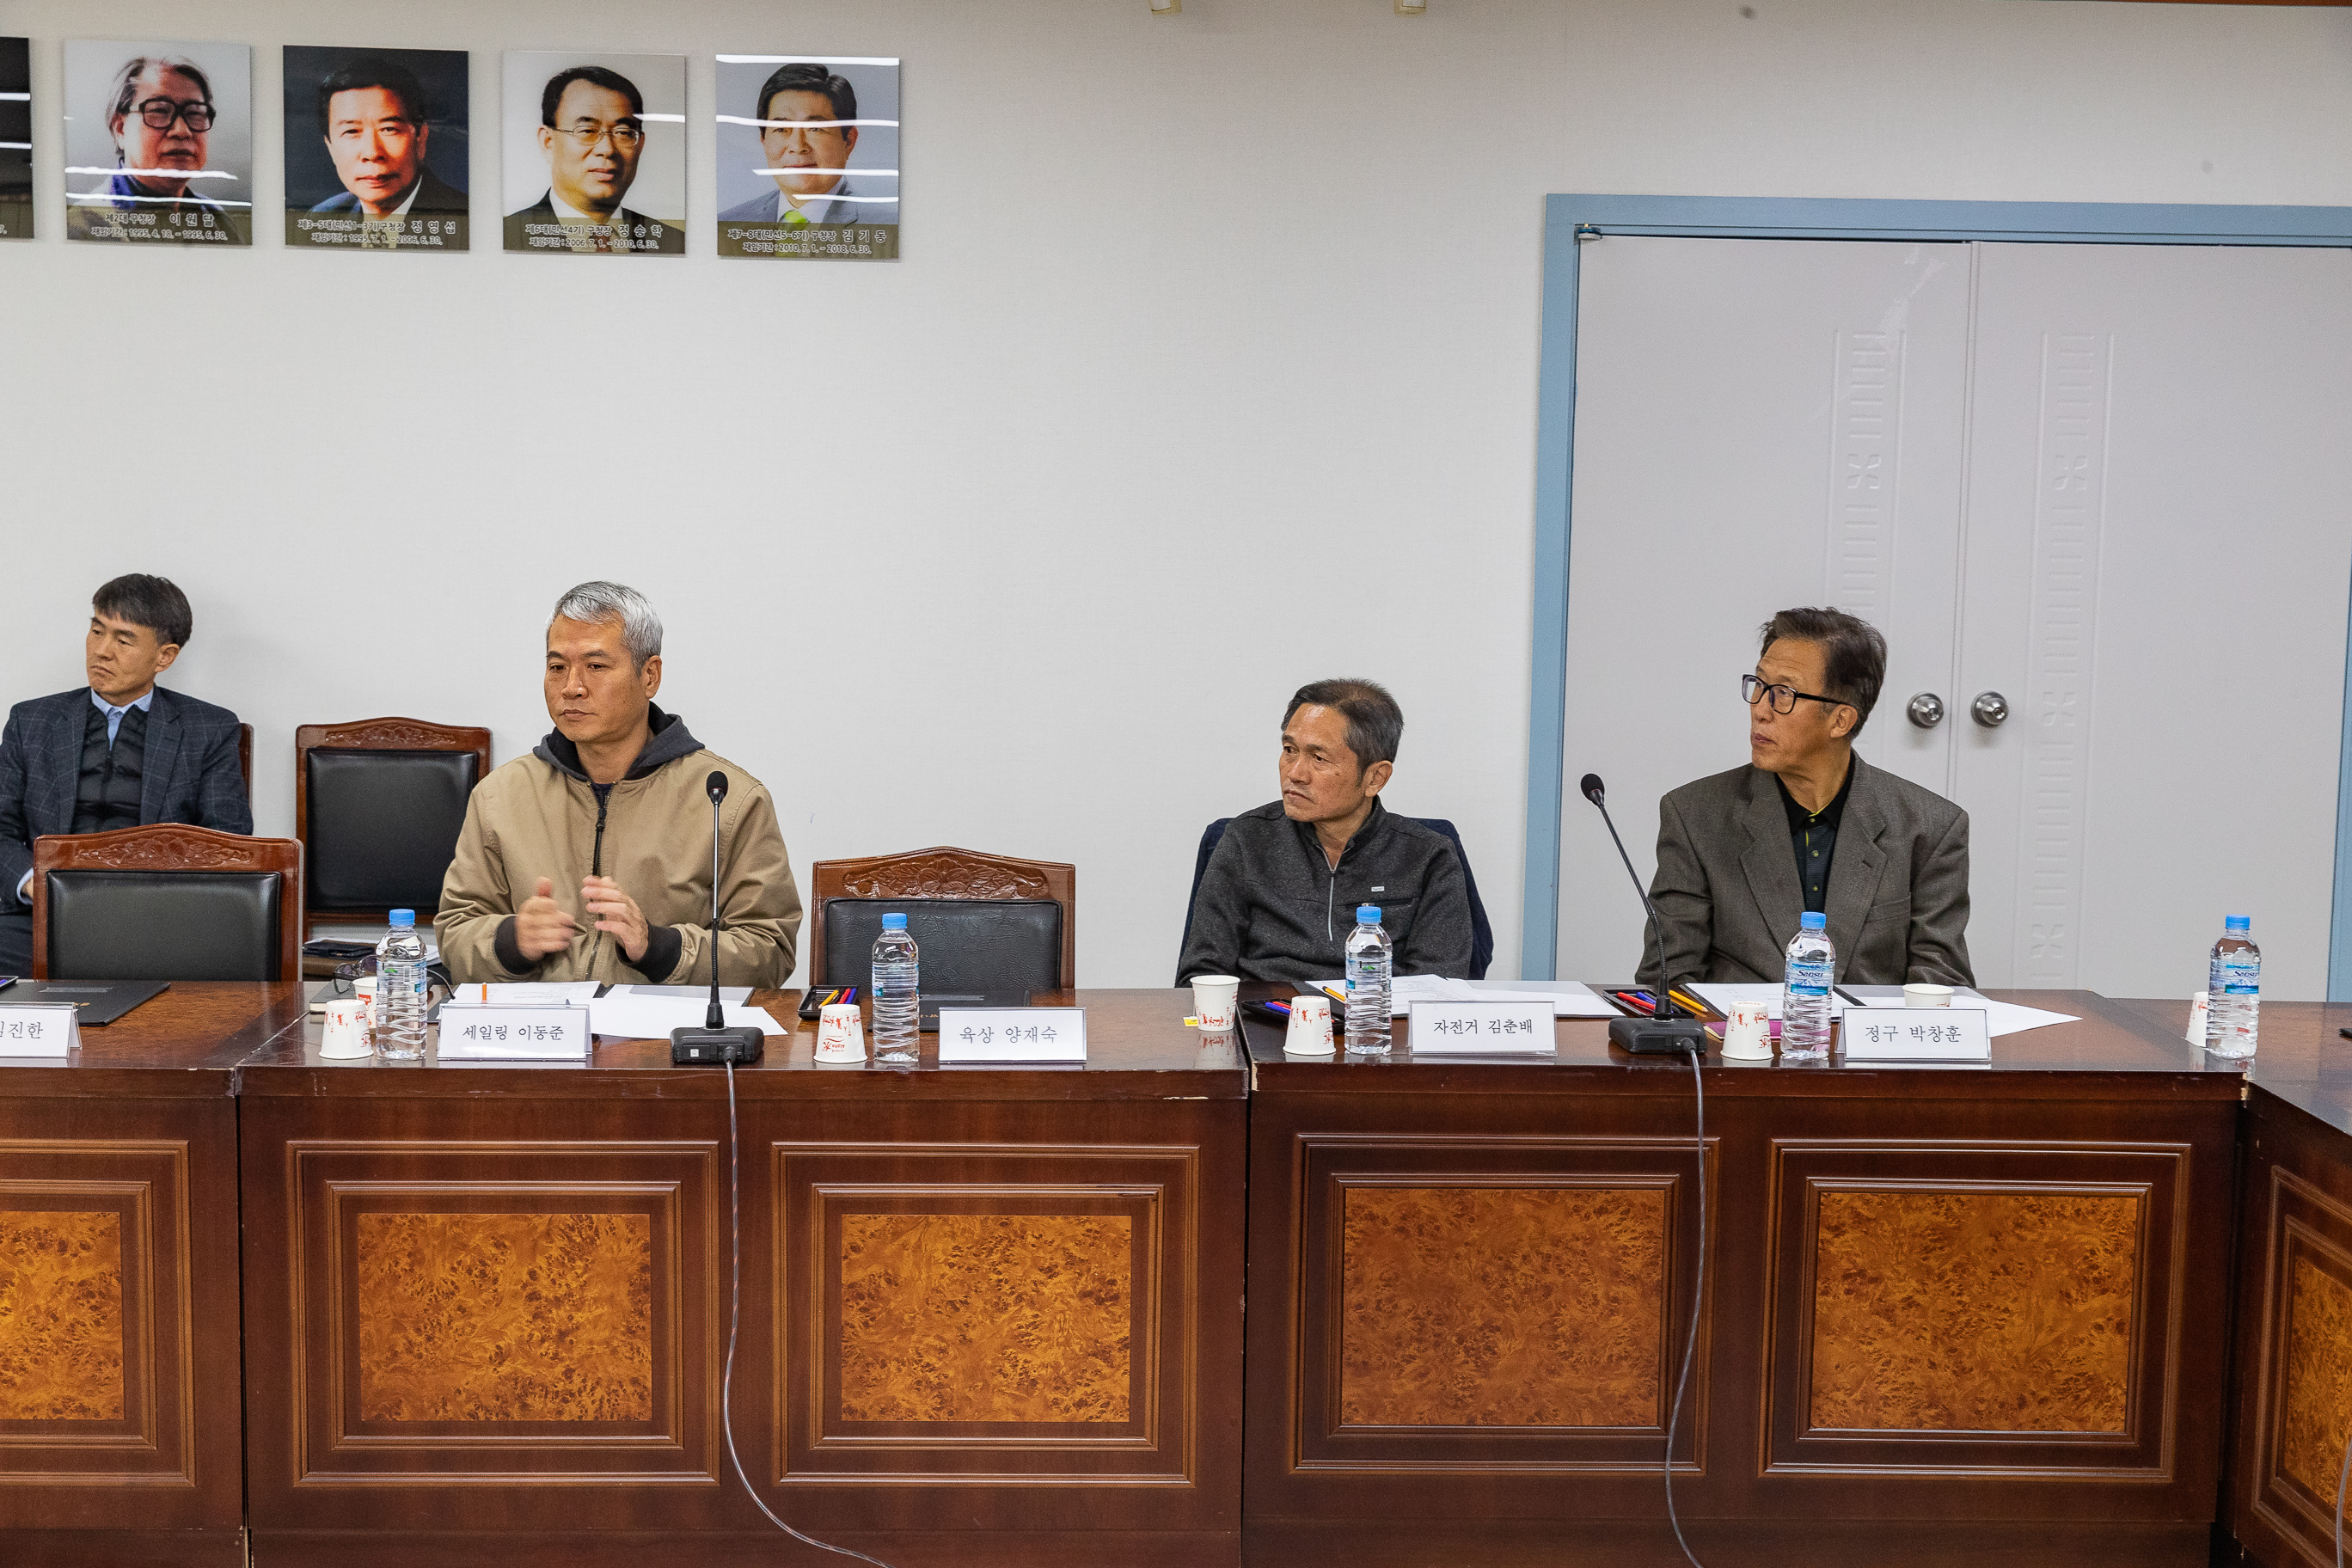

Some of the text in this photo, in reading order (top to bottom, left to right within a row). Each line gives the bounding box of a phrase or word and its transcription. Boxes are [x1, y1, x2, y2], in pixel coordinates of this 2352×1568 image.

[462, 1025, 564, 1041] 세일링 이동준
[959, 1026, 1057, 1044] 육상 양재숙
[1433, 1019, 1533, 1035] 자전거 김춘배
[1865, 1025, 1962, 1043] 정구 박창훈
